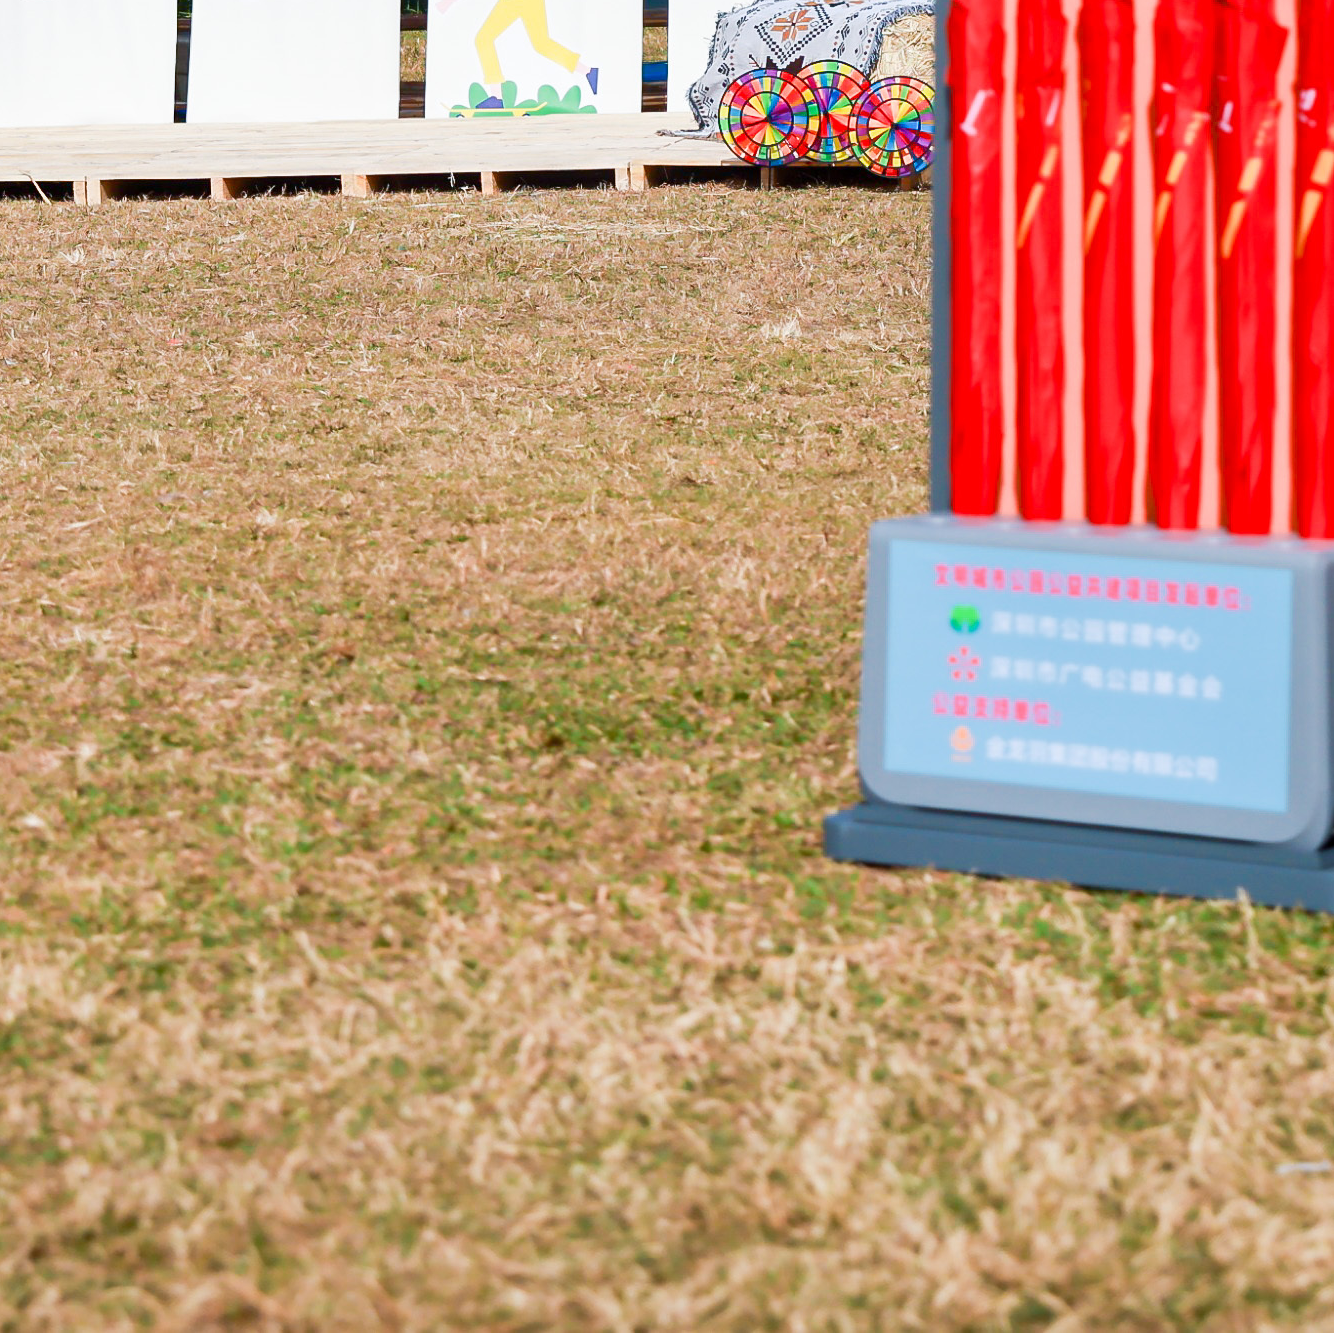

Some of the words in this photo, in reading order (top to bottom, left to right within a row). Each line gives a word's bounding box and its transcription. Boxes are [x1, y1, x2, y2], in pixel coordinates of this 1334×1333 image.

[992, 611, 1201, 652] 深圳市公园管理中心
